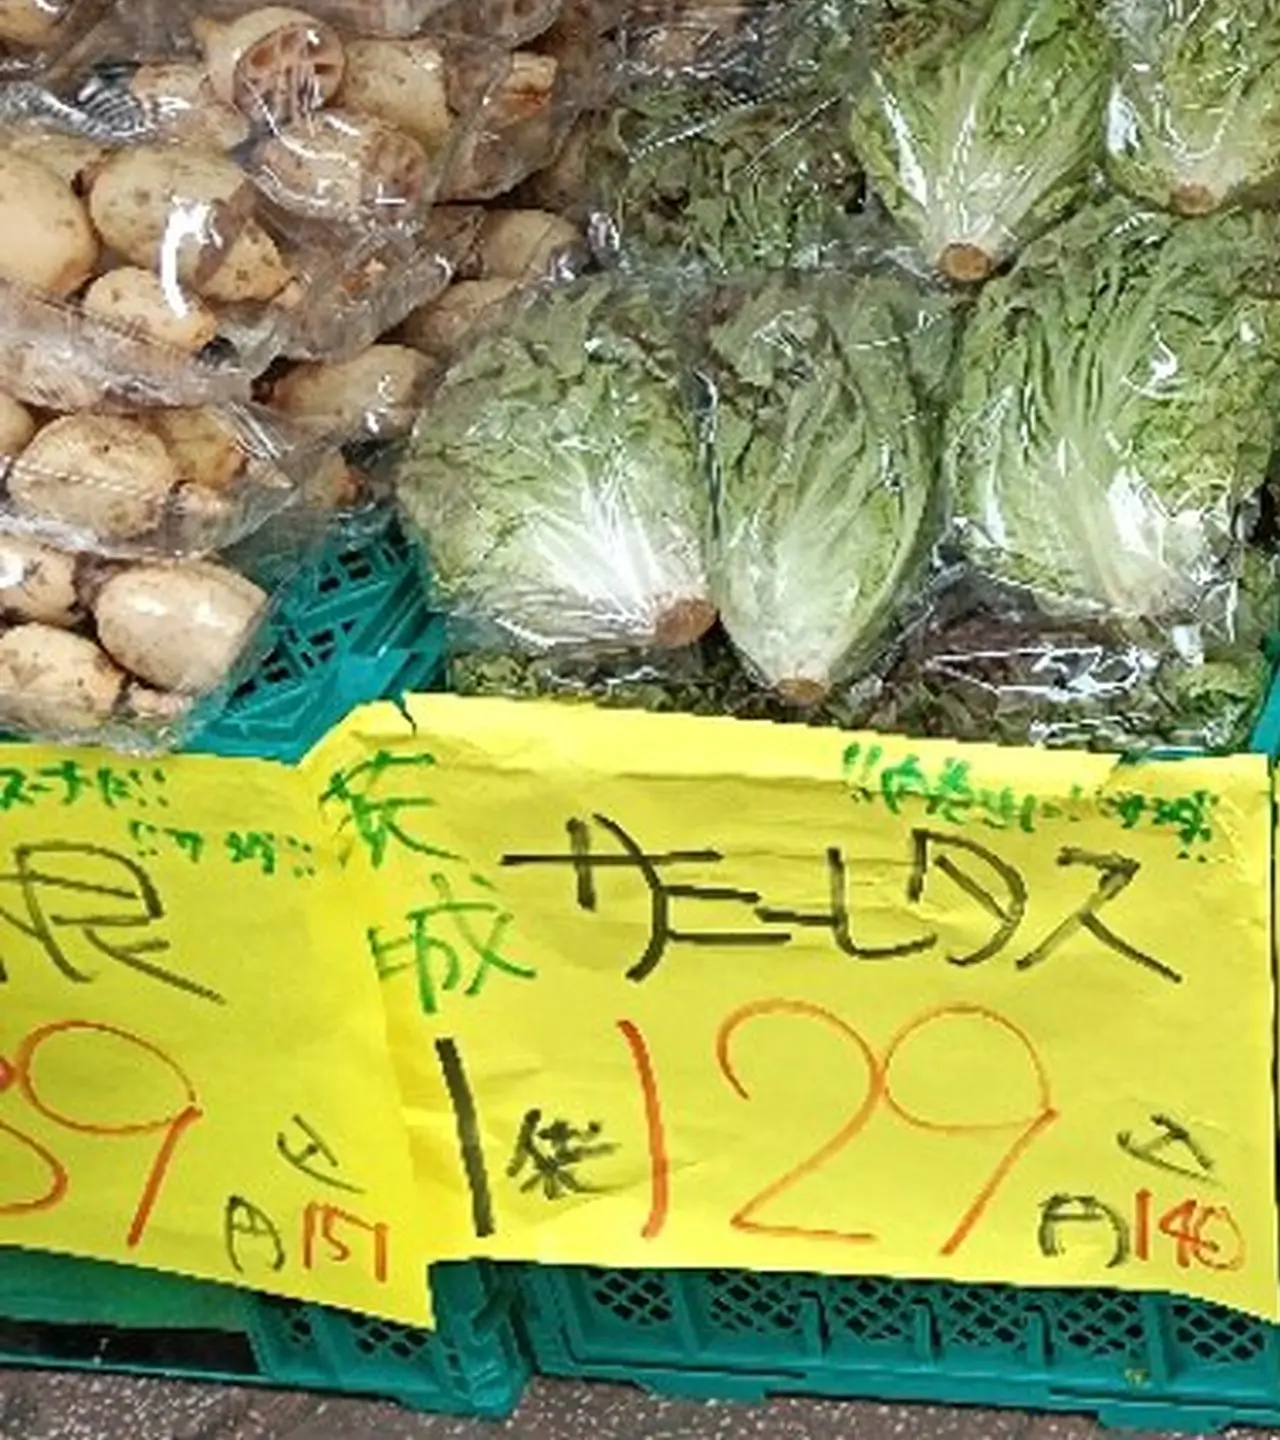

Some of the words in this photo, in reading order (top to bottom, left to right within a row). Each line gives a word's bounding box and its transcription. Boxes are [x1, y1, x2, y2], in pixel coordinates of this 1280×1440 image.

[500, 814, 1182, 980] サニーレタス
